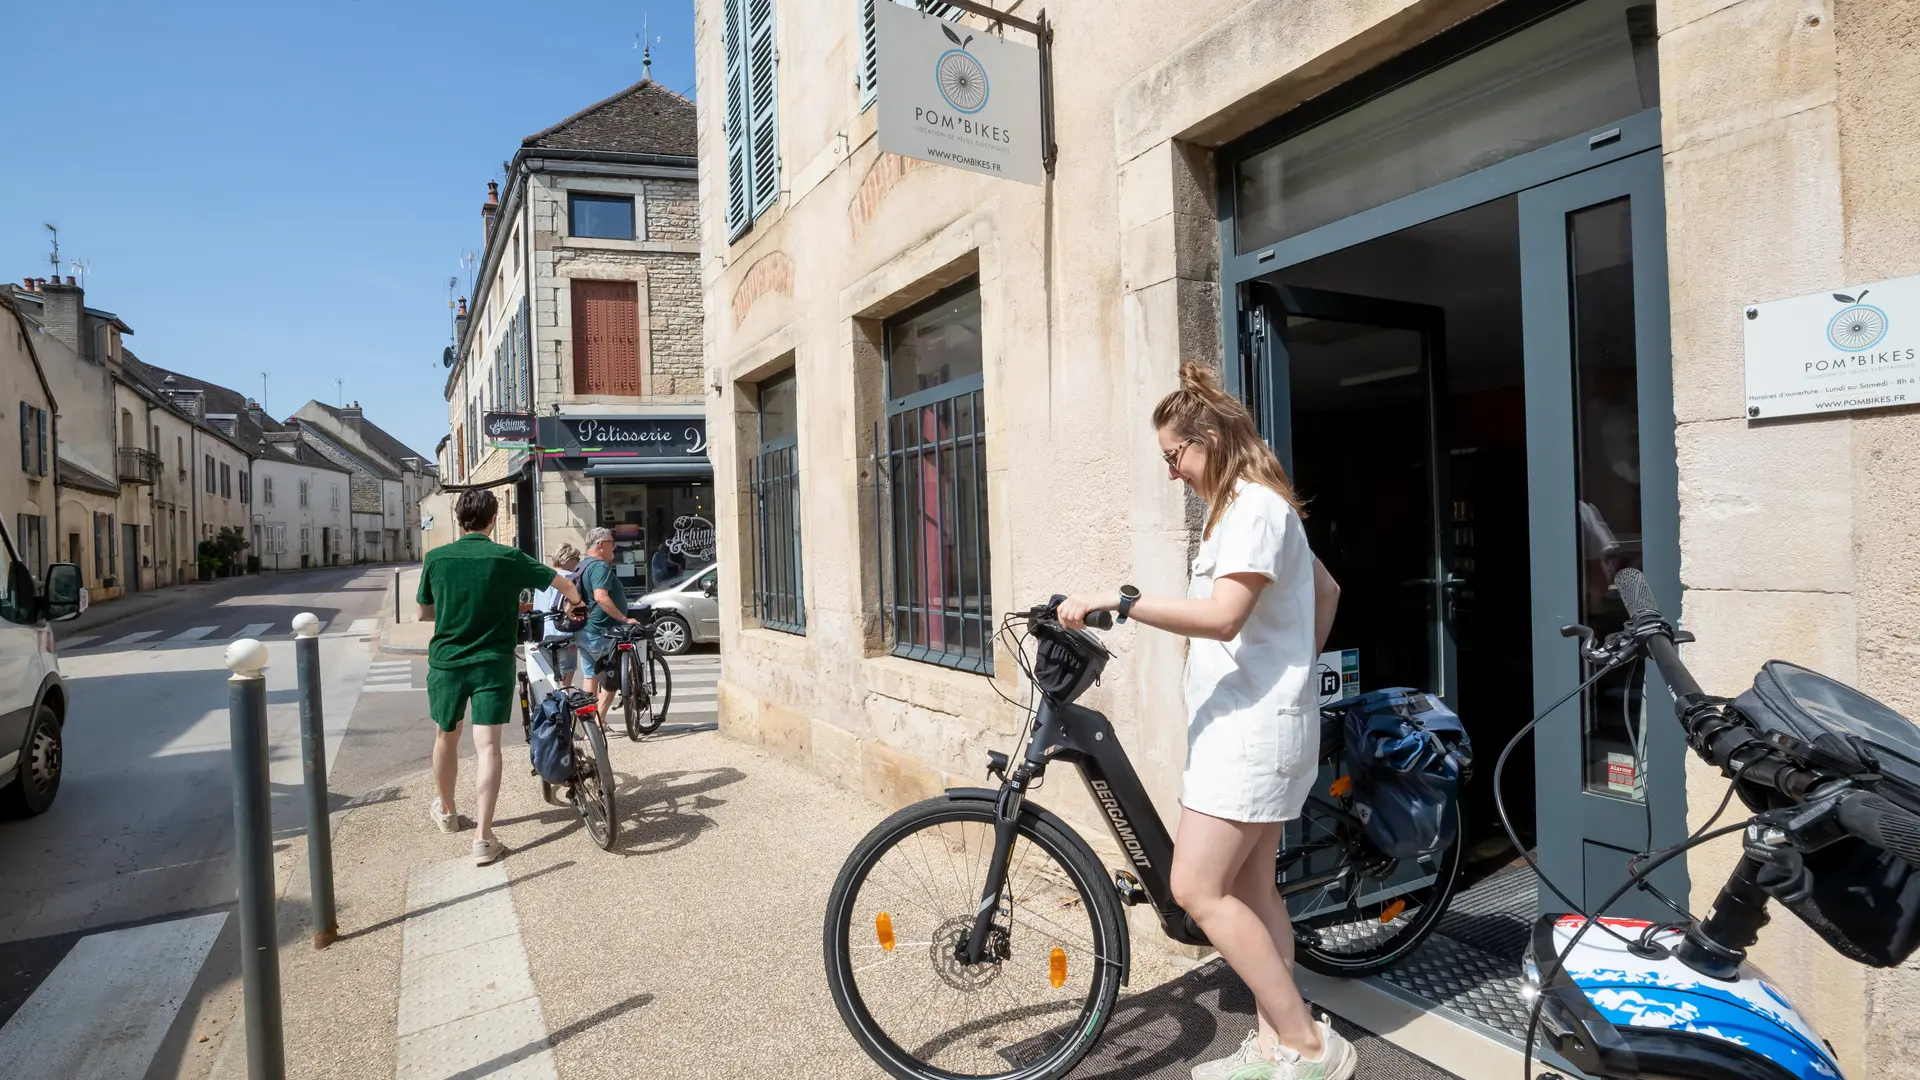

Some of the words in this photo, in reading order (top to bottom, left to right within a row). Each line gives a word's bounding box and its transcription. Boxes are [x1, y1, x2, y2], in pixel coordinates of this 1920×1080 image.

[927, 147, 1001, 172] WWW.POMBIKES.FR
[1778, 389, 1819, 398] d'ouverture
[1825, 384, 1846, 393] Lundi
[1859, 379, 1889, 389] Samedi
[1815, 394, 1906, 409] WWW.POMBIKES.FR
[578, 419, 672, 441] Pâtisserie
[683, 537, 715, 549] saveur
[1610, 765, 1632, 774] Alarme
[1091, 780, 1151, 868] BERGAMONT
